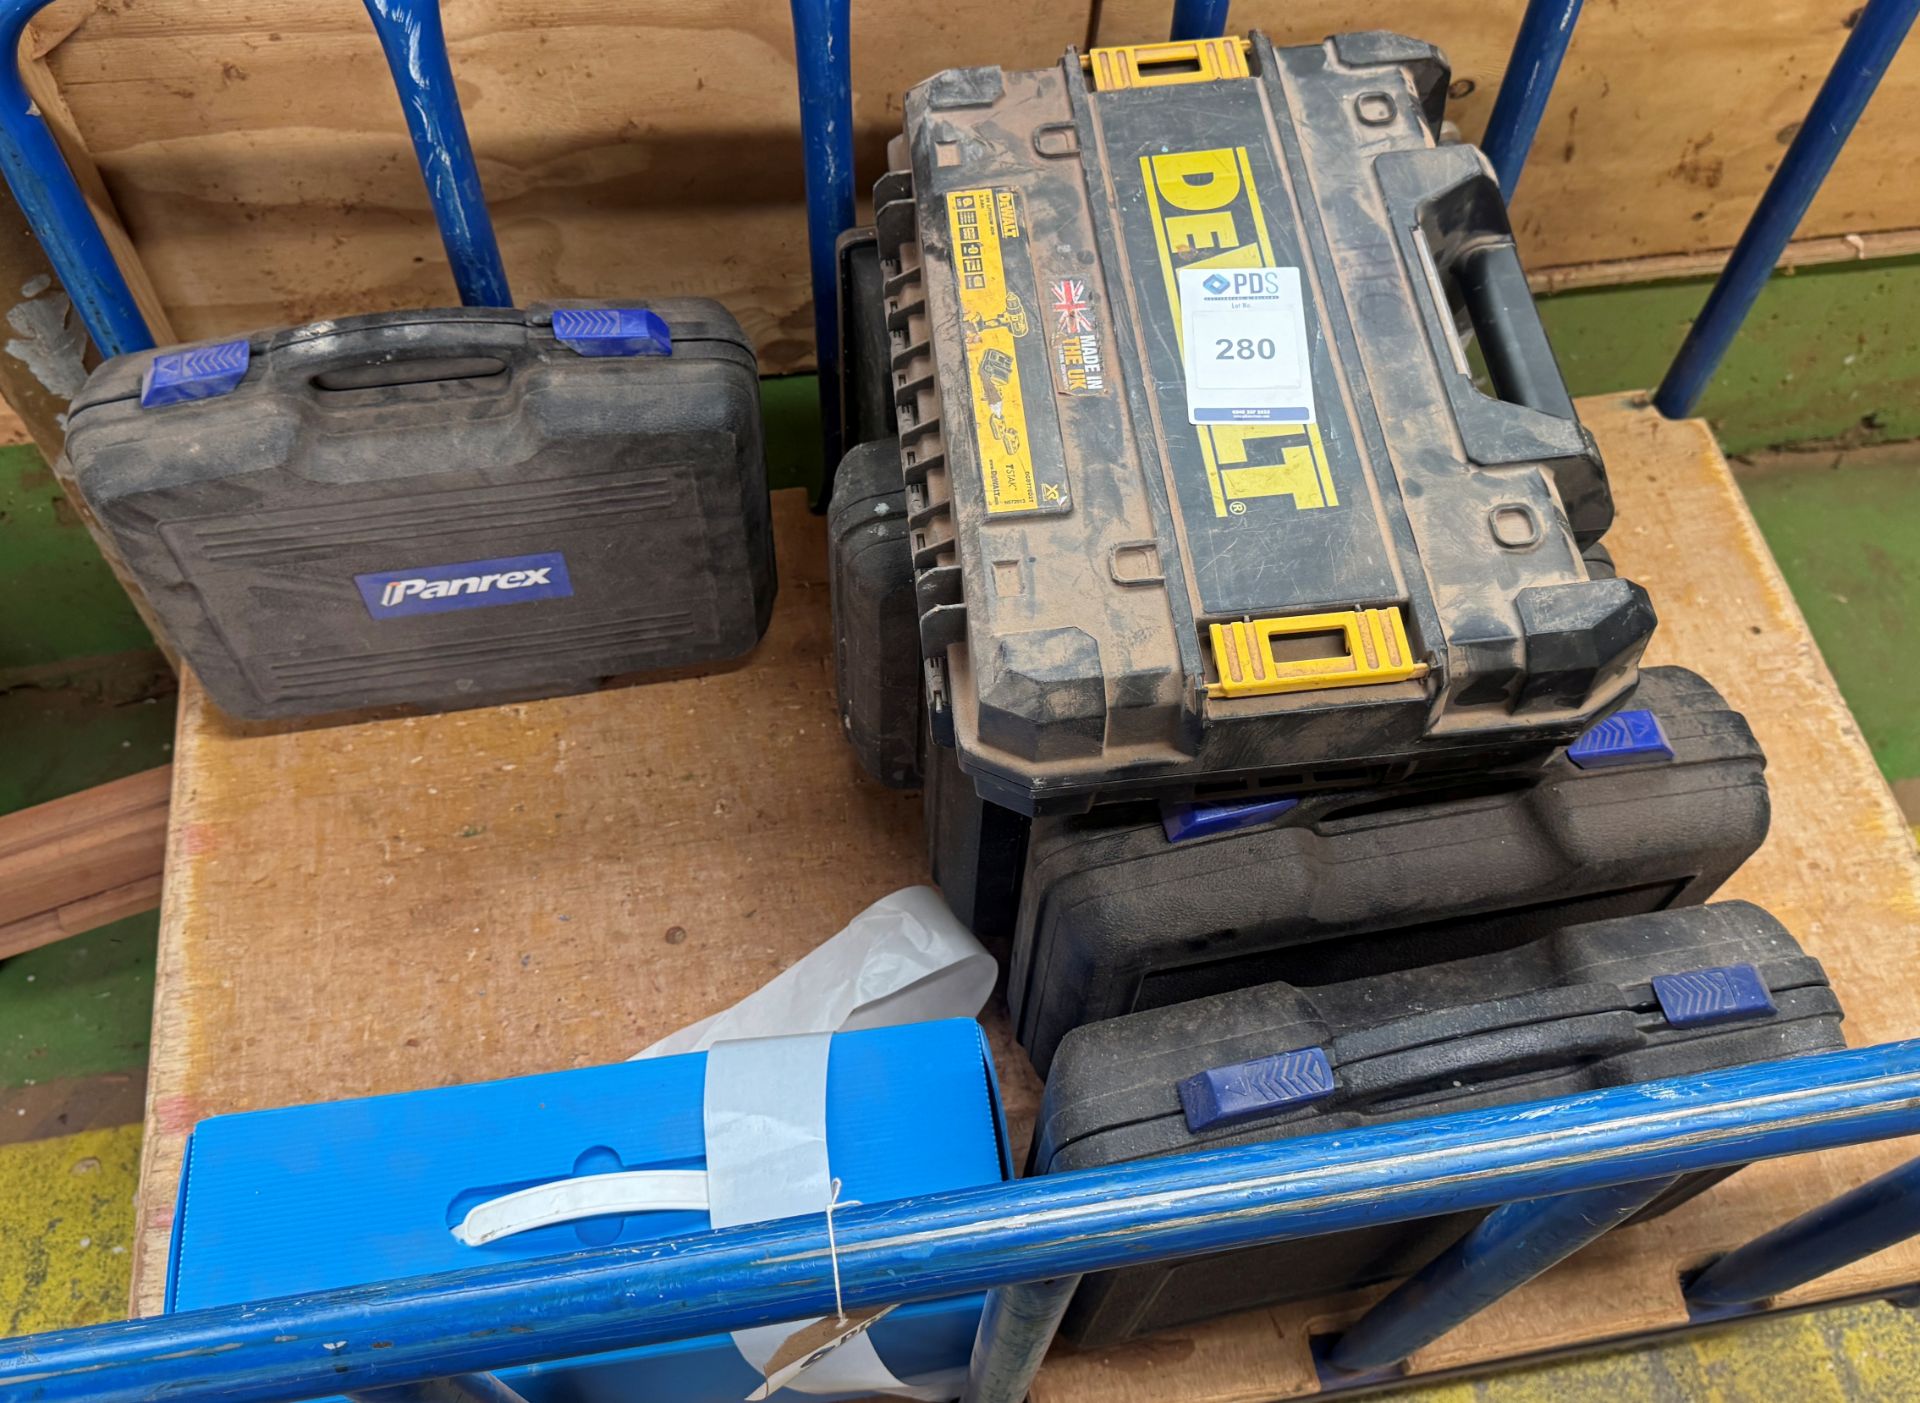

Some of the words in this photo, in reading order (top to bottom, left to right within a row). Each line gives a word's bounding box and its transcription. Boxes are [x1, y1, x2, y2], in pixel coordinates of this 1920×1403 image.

[1233, 271, 1279, 295] PDS
[1062, 336, 1083, 365] THE
[1080, 335, 1101, 372] MADE
[1215, 338, 1276, 360] 280
[1067, 368, 1088, 391] UK
[1086, 375, 1104, 390] IN
[380, 567, 552, 607] Panrex
